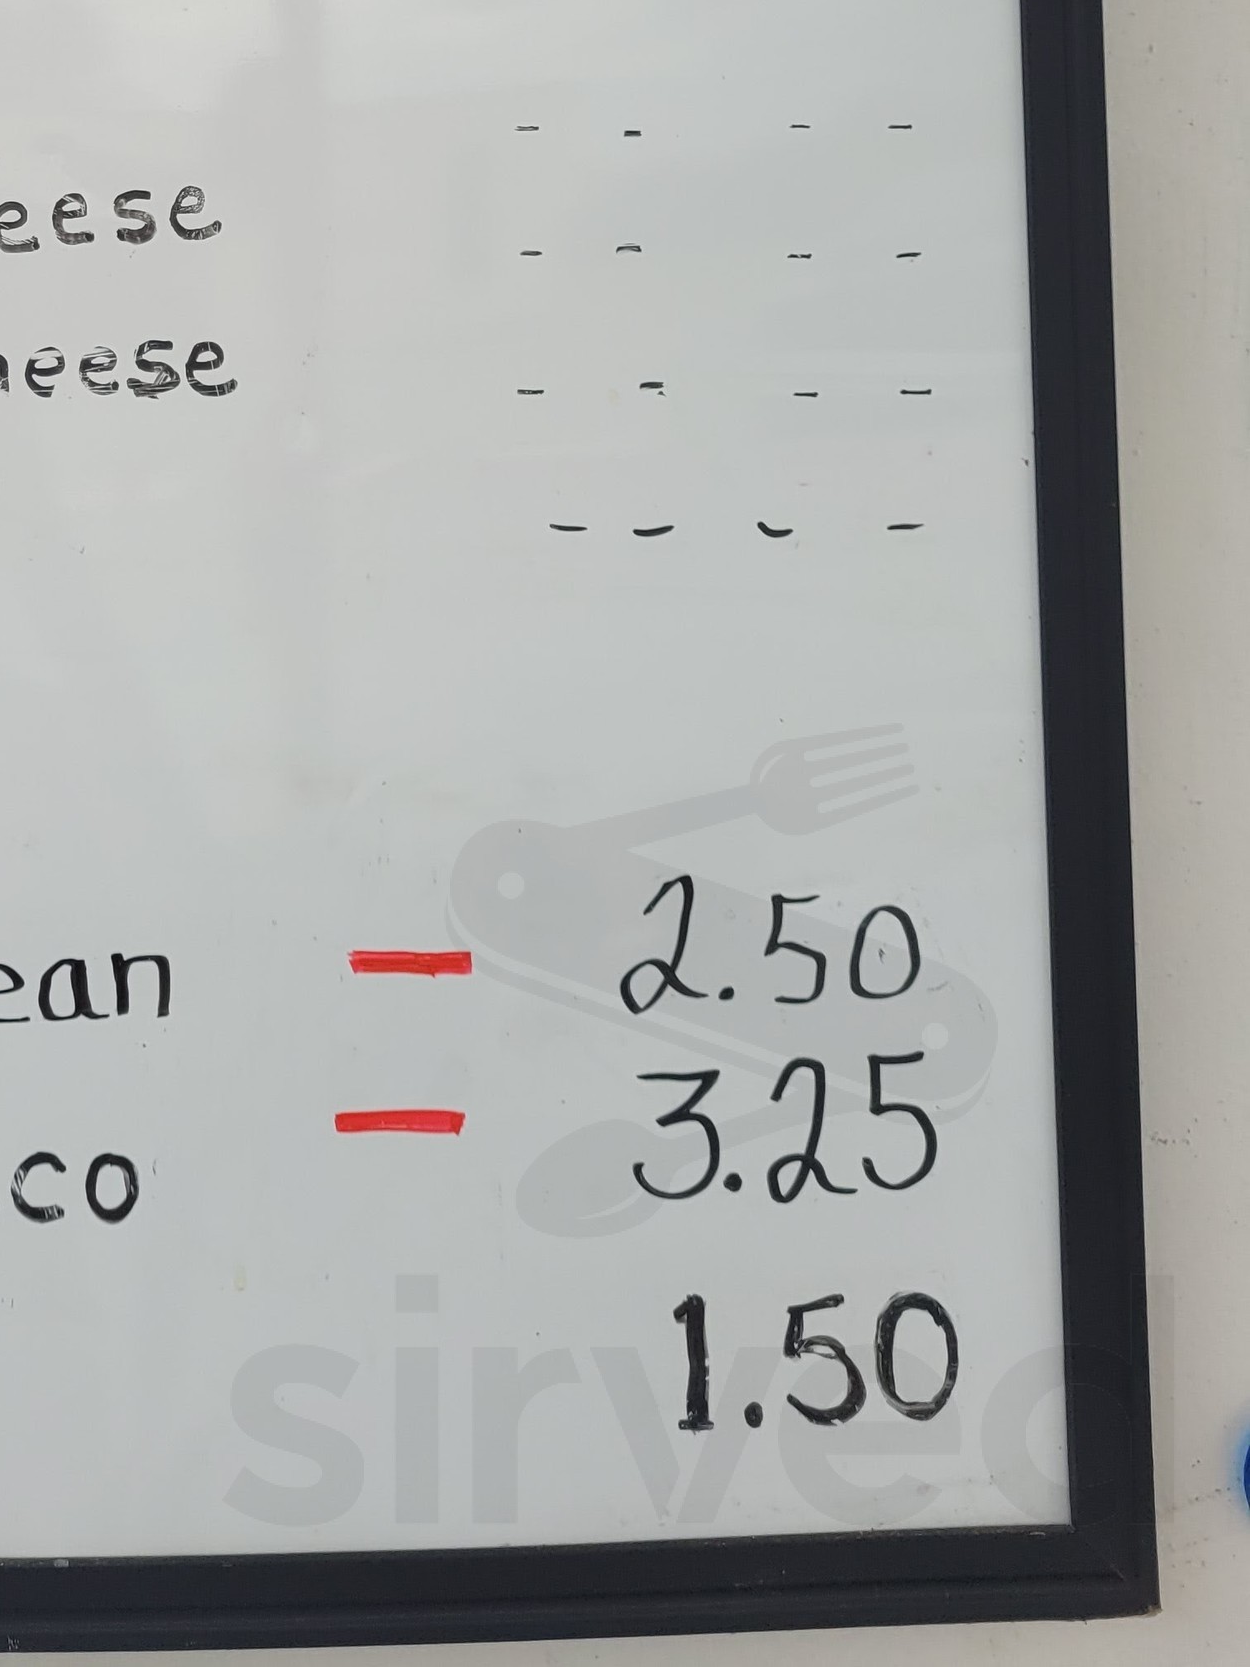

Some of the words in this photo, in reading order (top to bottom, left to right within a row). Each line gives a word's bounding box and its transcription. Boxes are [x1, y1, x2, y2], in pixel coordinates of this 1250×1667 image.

[618, 873, 922, 1016] 2.50
[631, 1050, 939, 1205] 3.25
[672, 1291, 960, 1433] 1.50
